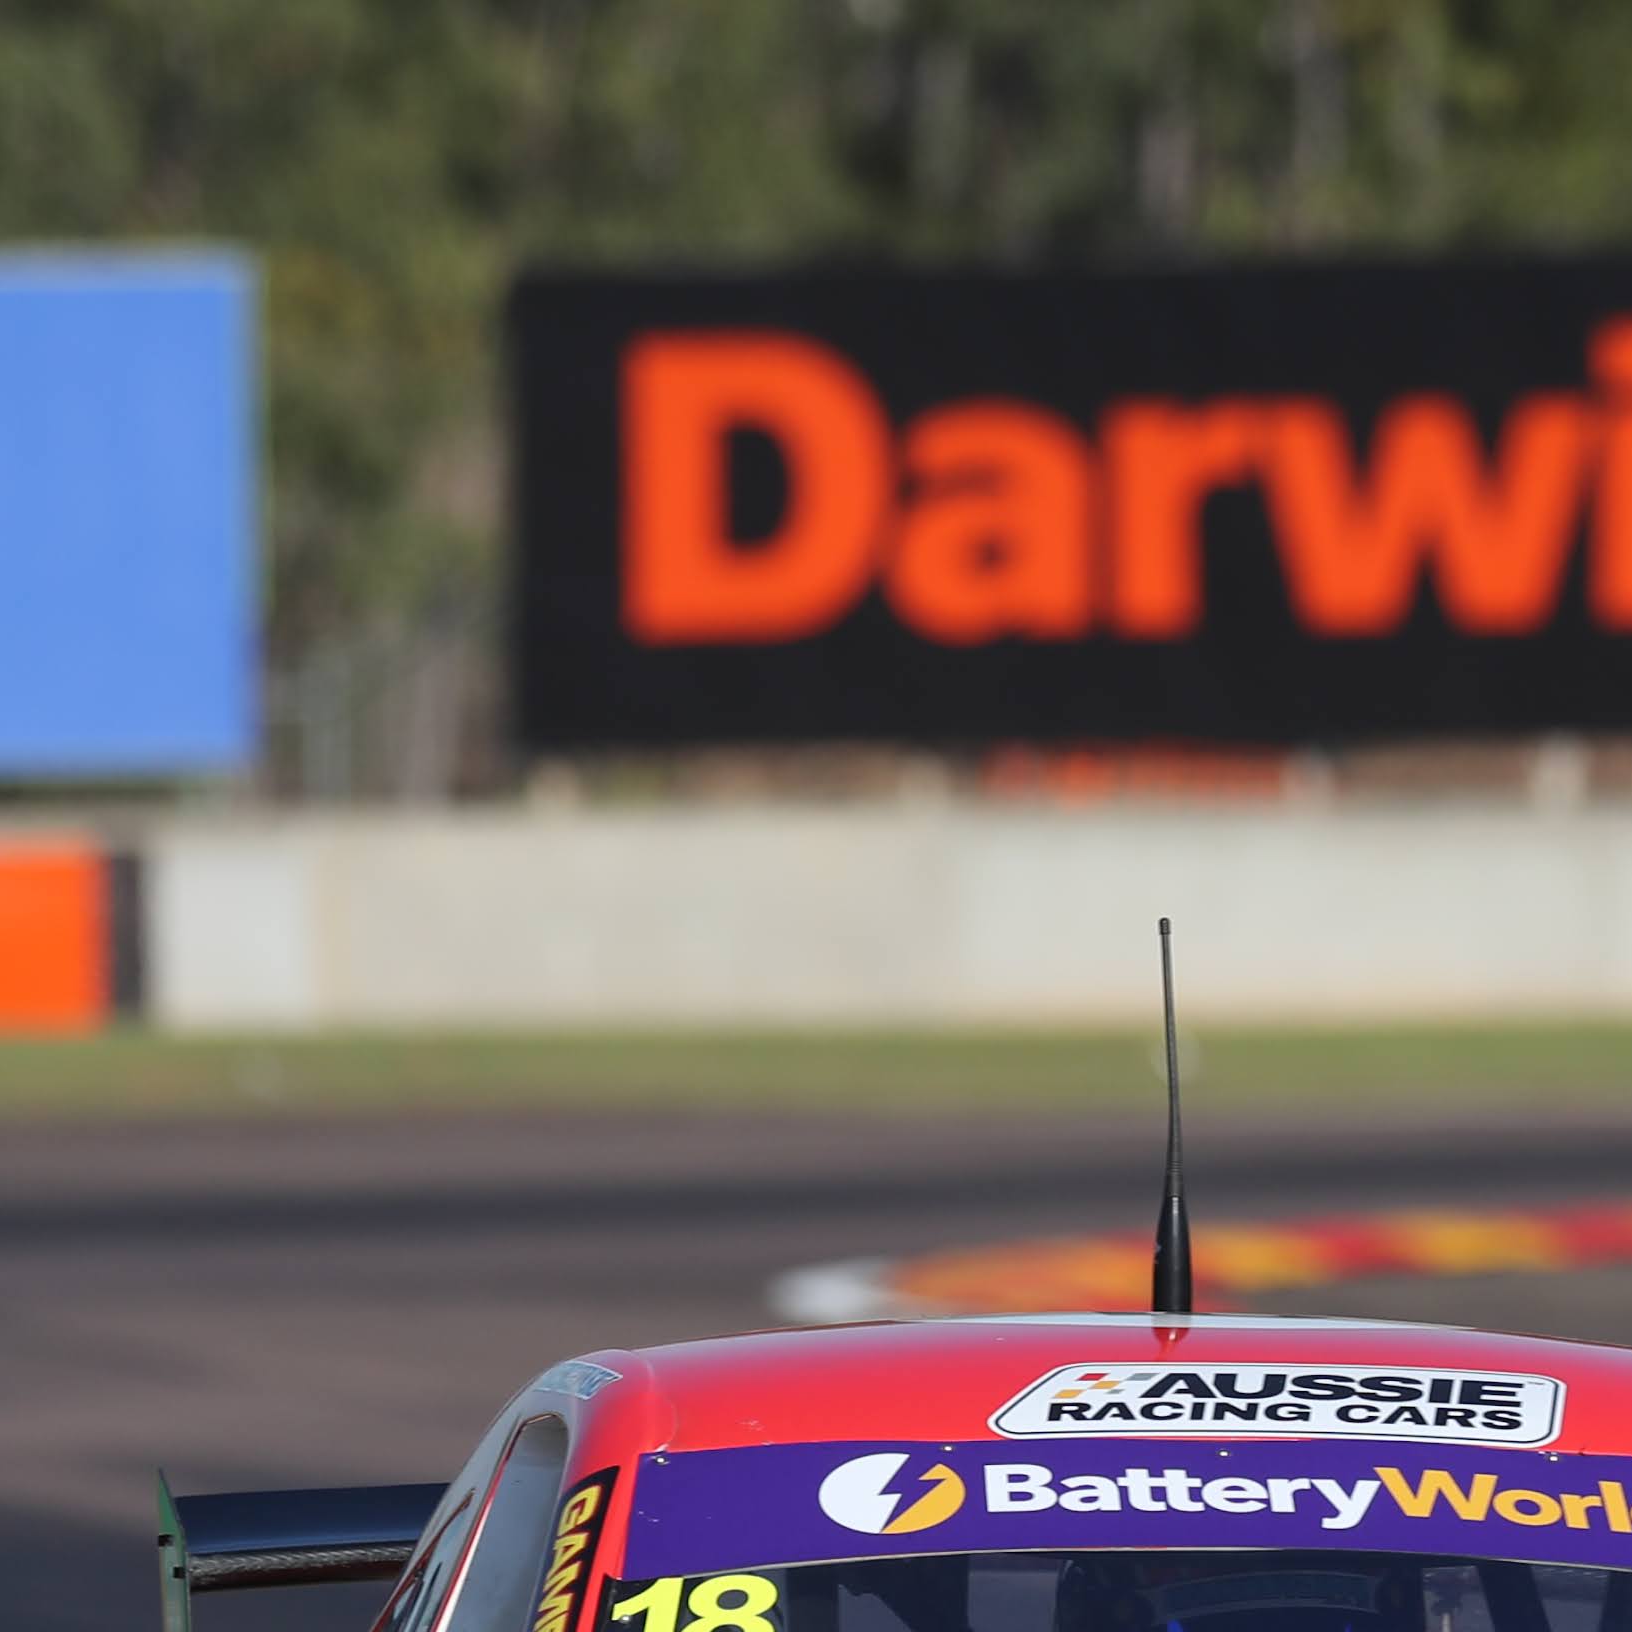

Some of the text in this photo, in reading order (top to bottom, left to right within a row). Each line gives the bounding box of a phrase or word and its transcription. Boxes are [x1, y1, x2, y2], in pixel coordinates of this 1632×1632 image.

[1140, 1372, 1524, 1407] AUSSIE
[1047, 1401, 1523, 1430] RACING CARS
